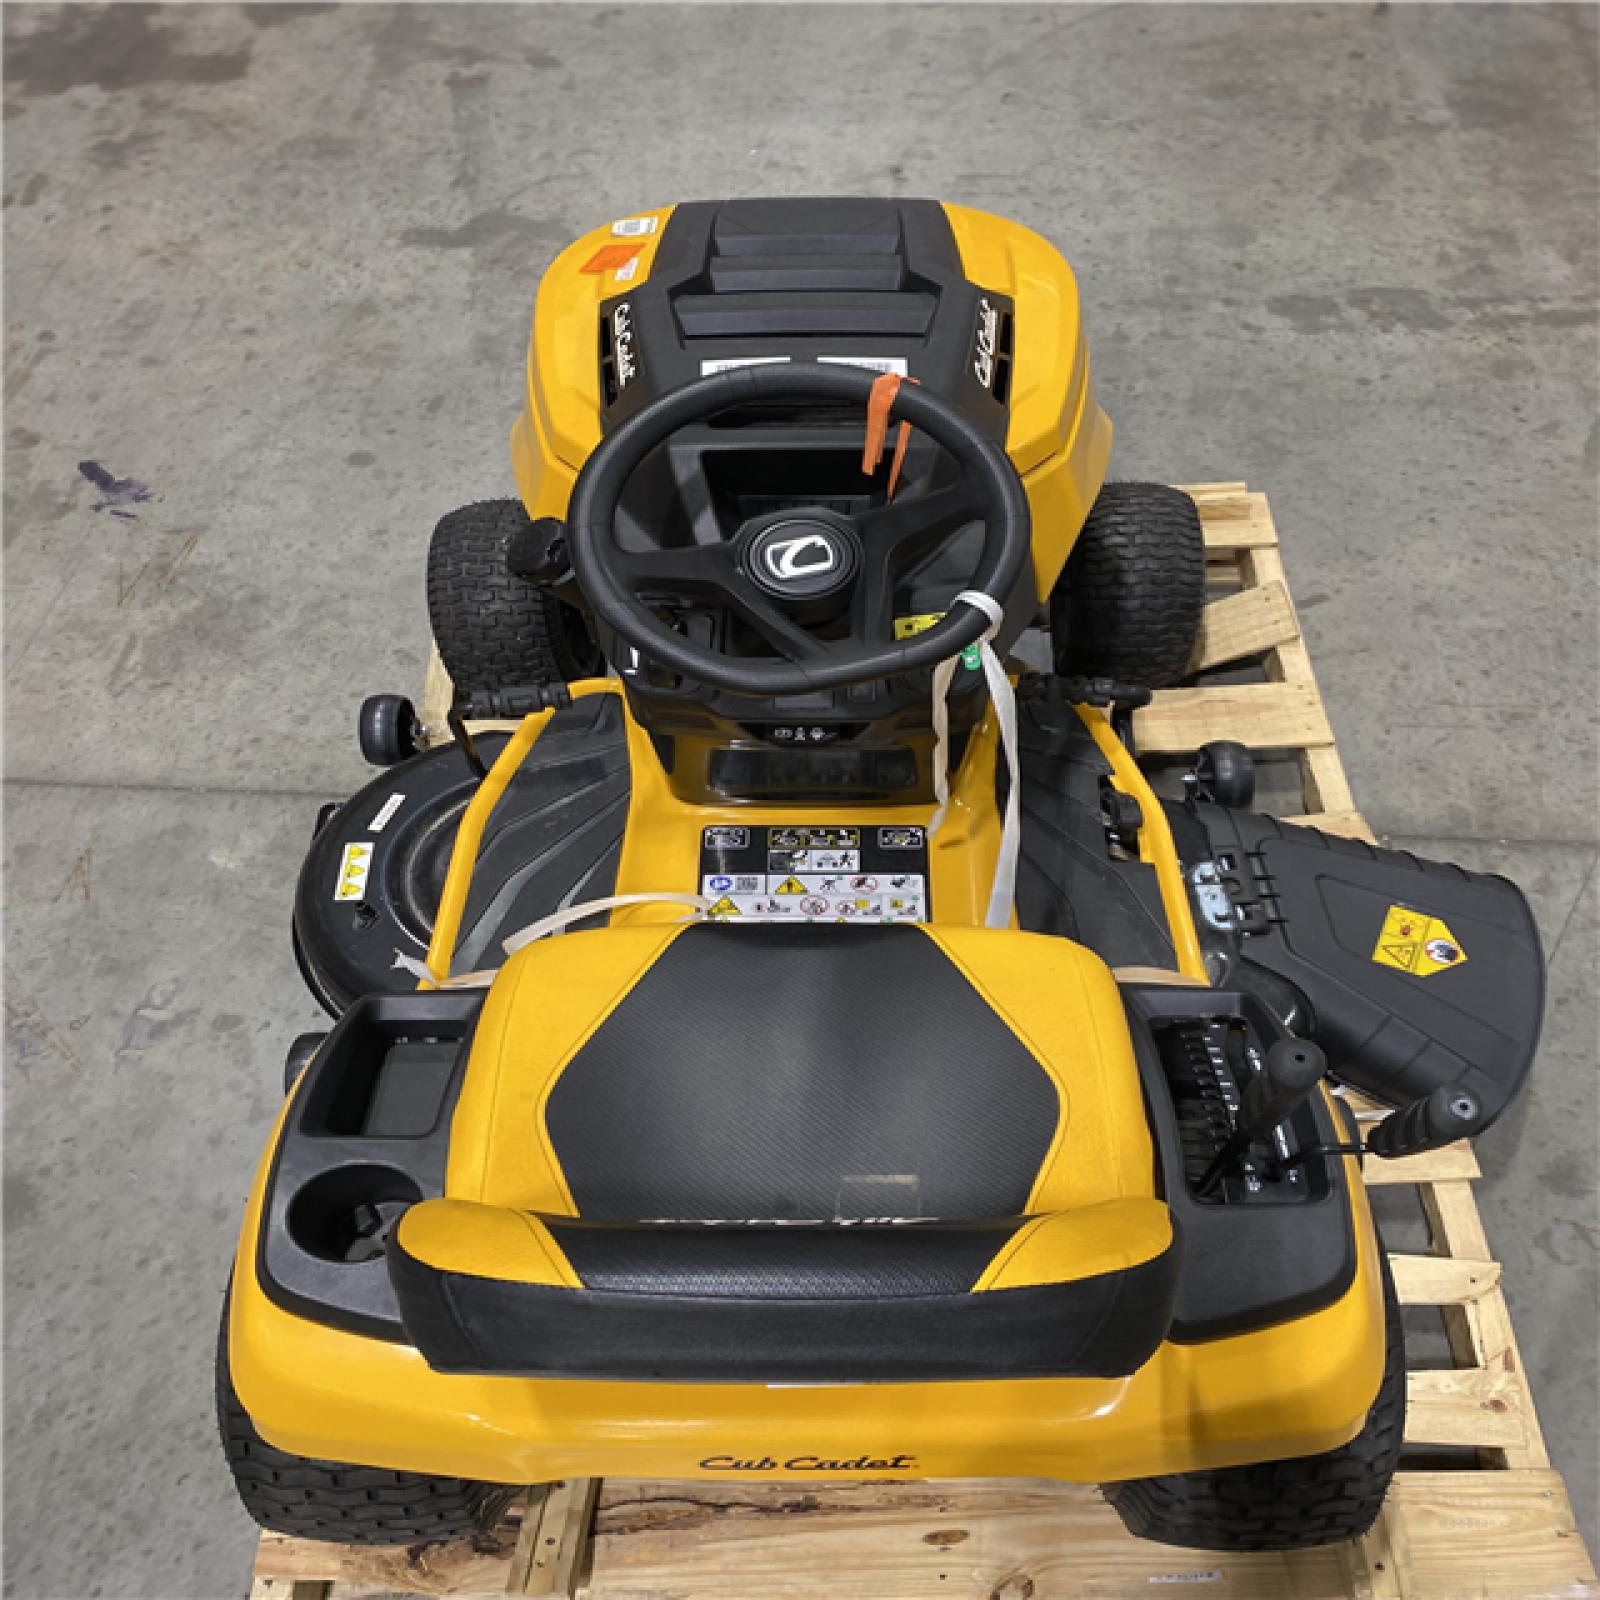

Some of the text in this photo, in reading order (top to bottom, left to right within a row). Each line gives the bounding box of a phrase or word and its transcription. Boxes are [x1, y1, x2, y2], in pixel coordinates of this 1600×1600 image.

[614, 303, 636, 390] Cub Cadet
[974, 298, 997, 388] Cub Cadet
[699, 1454, 917, 1471] Cub Cadet
